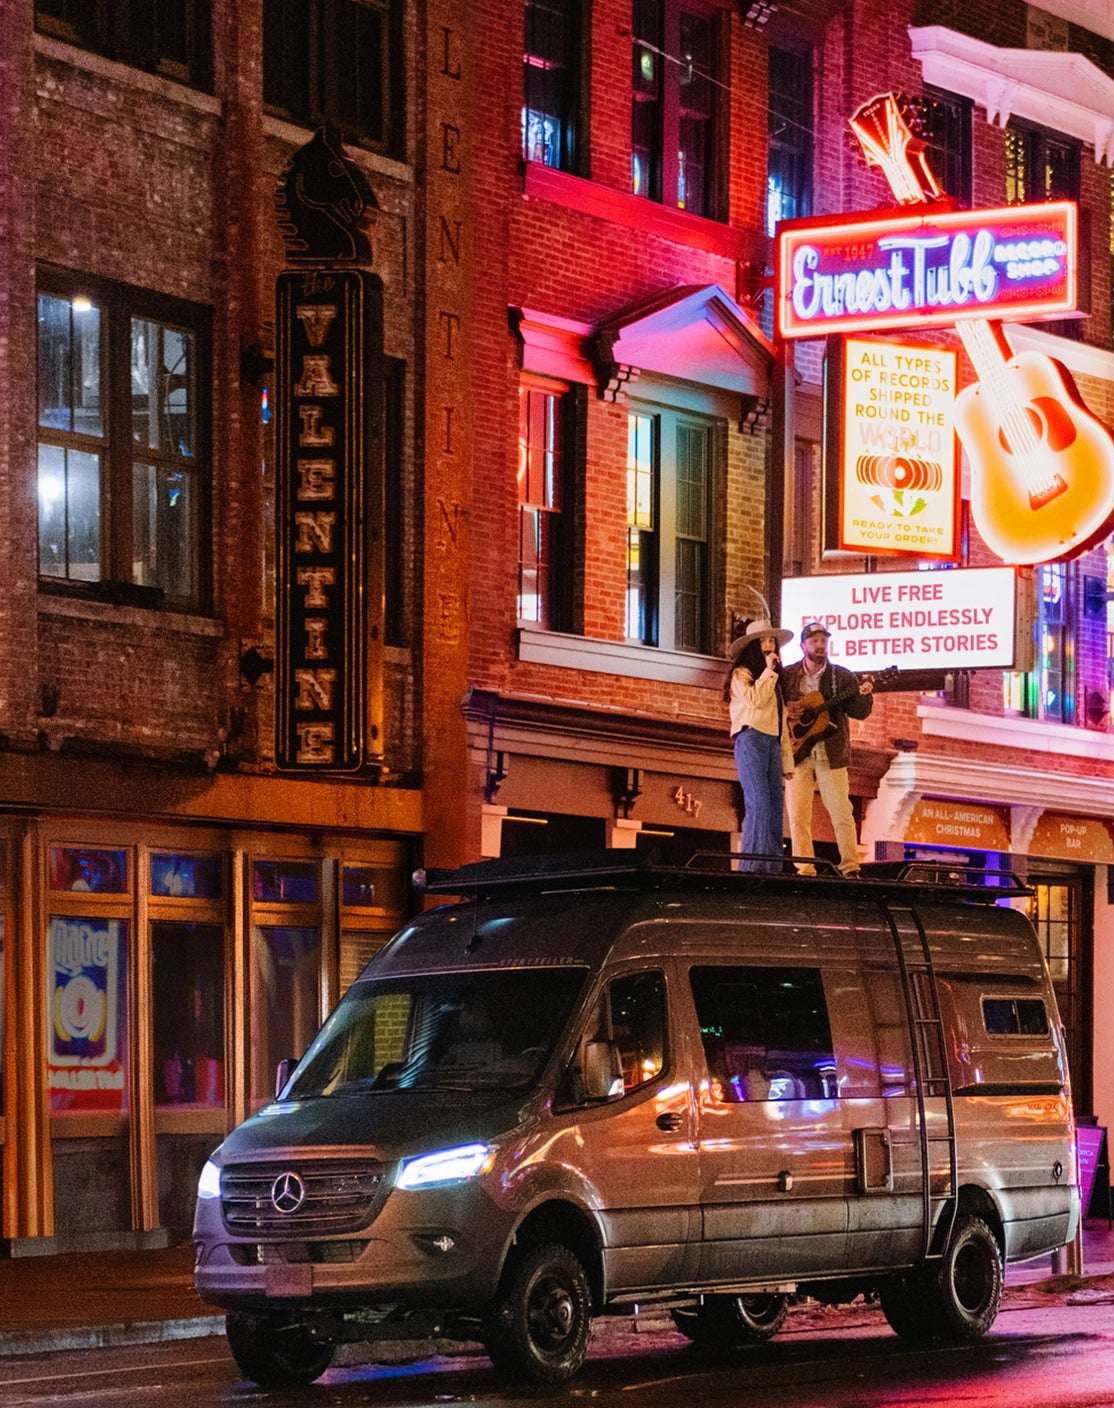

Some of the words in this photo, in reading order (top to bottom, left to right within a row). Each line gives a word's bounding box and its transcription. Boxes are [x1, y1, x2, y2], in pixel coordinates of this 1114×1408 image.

[995, 239, 1067, 264] RECORD
[793, 245, 912, 320] Ernest
[877, 229, 997, 308] Tubb
[1006, 258, 1061, 281] SHOP
[861, 352, 887, 367] ALL
[895, 355, 941, 374] TYPES
[851, 368, 872, 383] OF
[879, 371, 950, 393] RECORDS
[869, 387, 933, 408] SHIPPED
[855, 403, 911, 423] ROUND
[918, 410, 945, 427] THE
[294, 304, 339, 765] VALENTINE
[852, 519, 893, 531] READY
[897, 523, 912, 533] TO
[915, 525, 944, 536] TAKE
[859, 530, 891, 541] YOUR
[851, 585, 893, 605] LIVE
[898, 583, 944, 602] FREE
[889, 607, 995, 629] ENDLESSLY
[845, 635, 915, 658] BETTER
[920, 633, 999, 654] STORIES
[674, 785, 703, 819] 417
[922, 808, 934, 818] AN
[935, 824, 982, 839] CHRISTMAS
[1060, 823, 1087, 837] POP-UP
[1066, 838, 1082, 849] BAR
